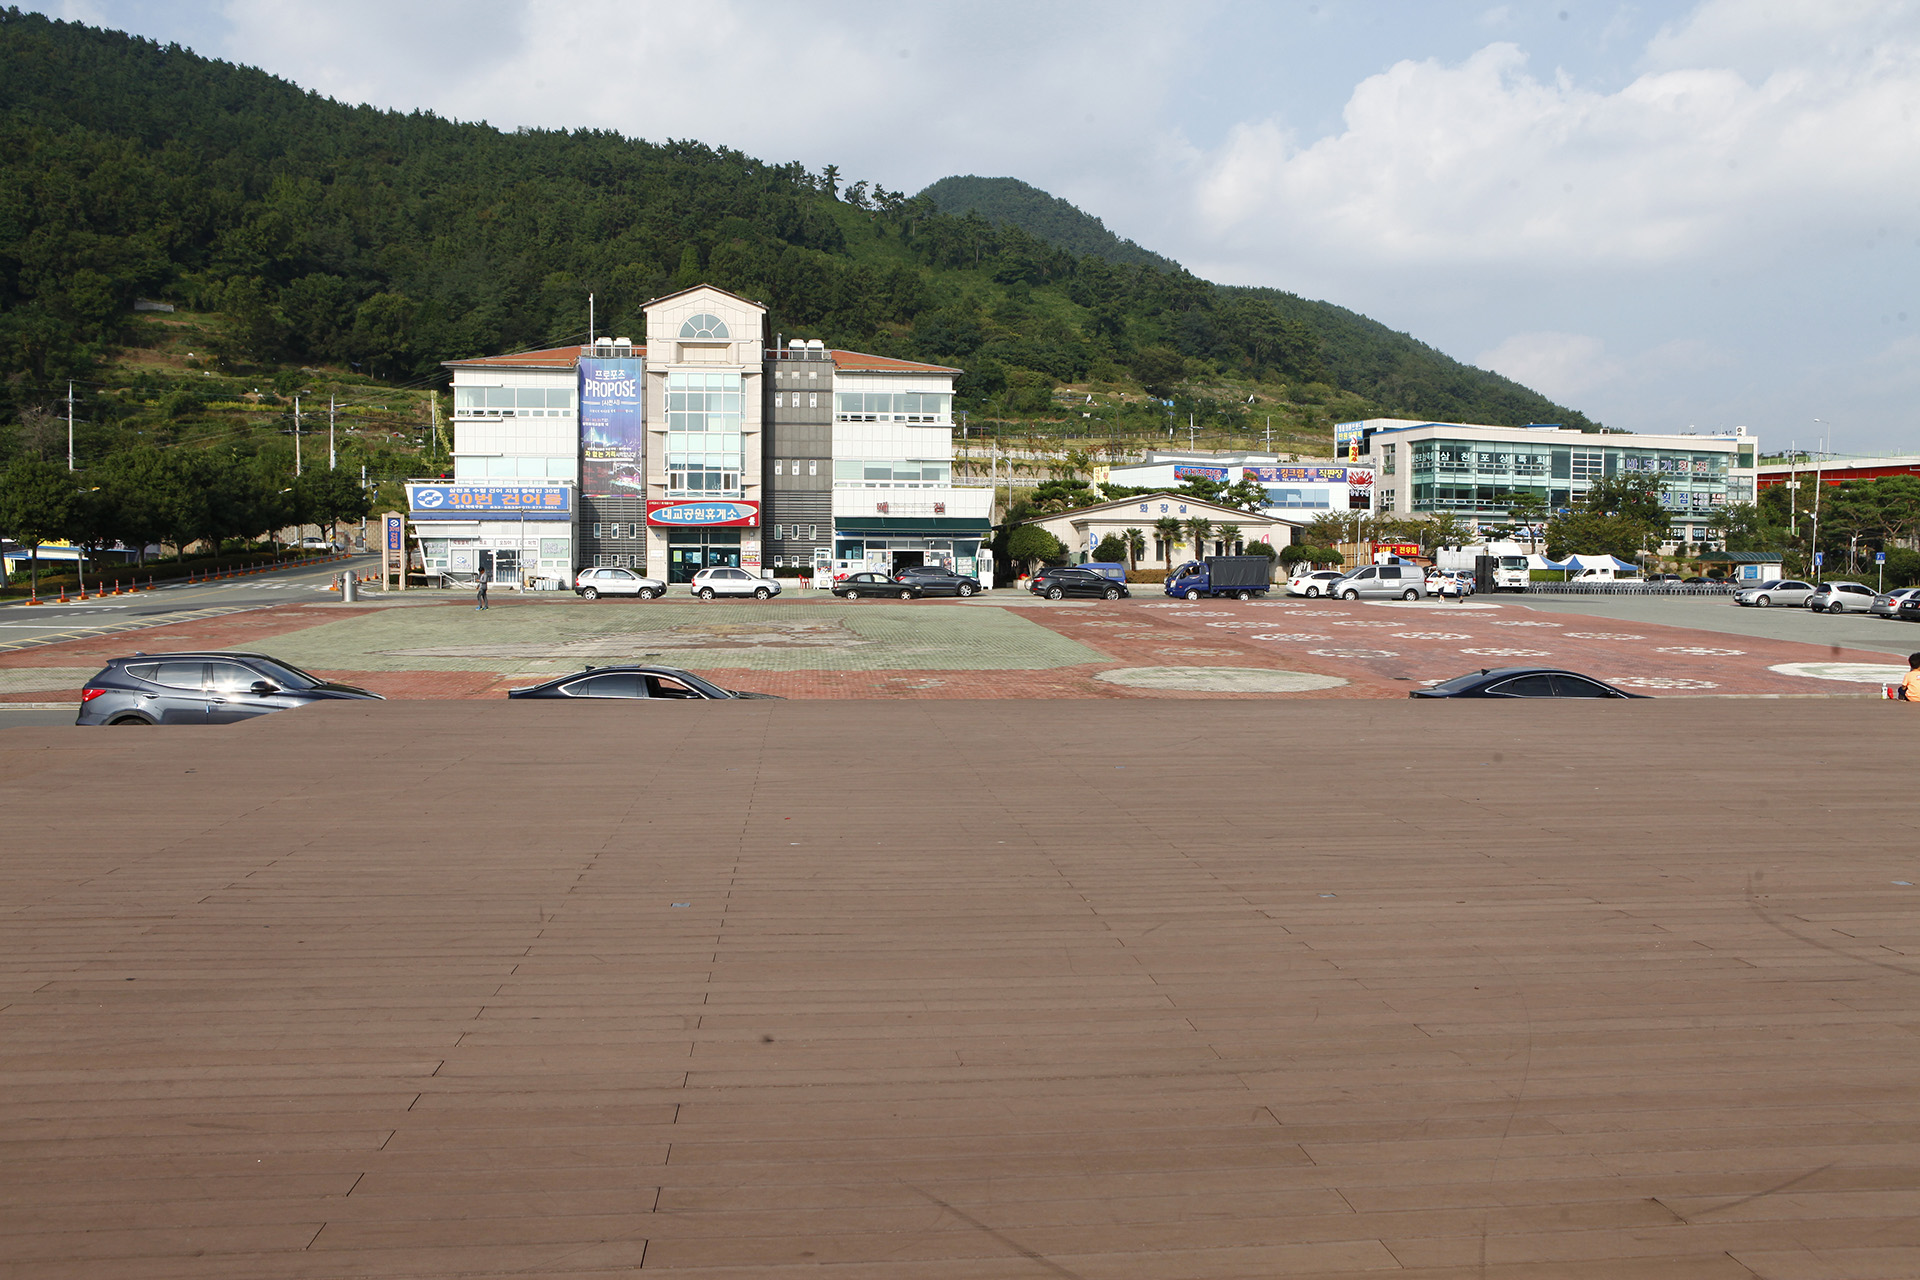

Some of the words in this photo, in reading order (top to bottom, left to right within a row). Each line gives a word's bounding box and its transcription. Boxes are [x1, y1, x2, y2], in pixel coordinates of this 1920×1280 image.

[595, 369, 625, 380] 프로포즈
[585, 378, 636, 397] PROPOSE
[1318, 469, 1344, 479] 직판장
[448, 493, 493, 505] 30번
[501, 493, 562, 506] 건어물
[661, 508, 738, 521] 대교공원휴게소
